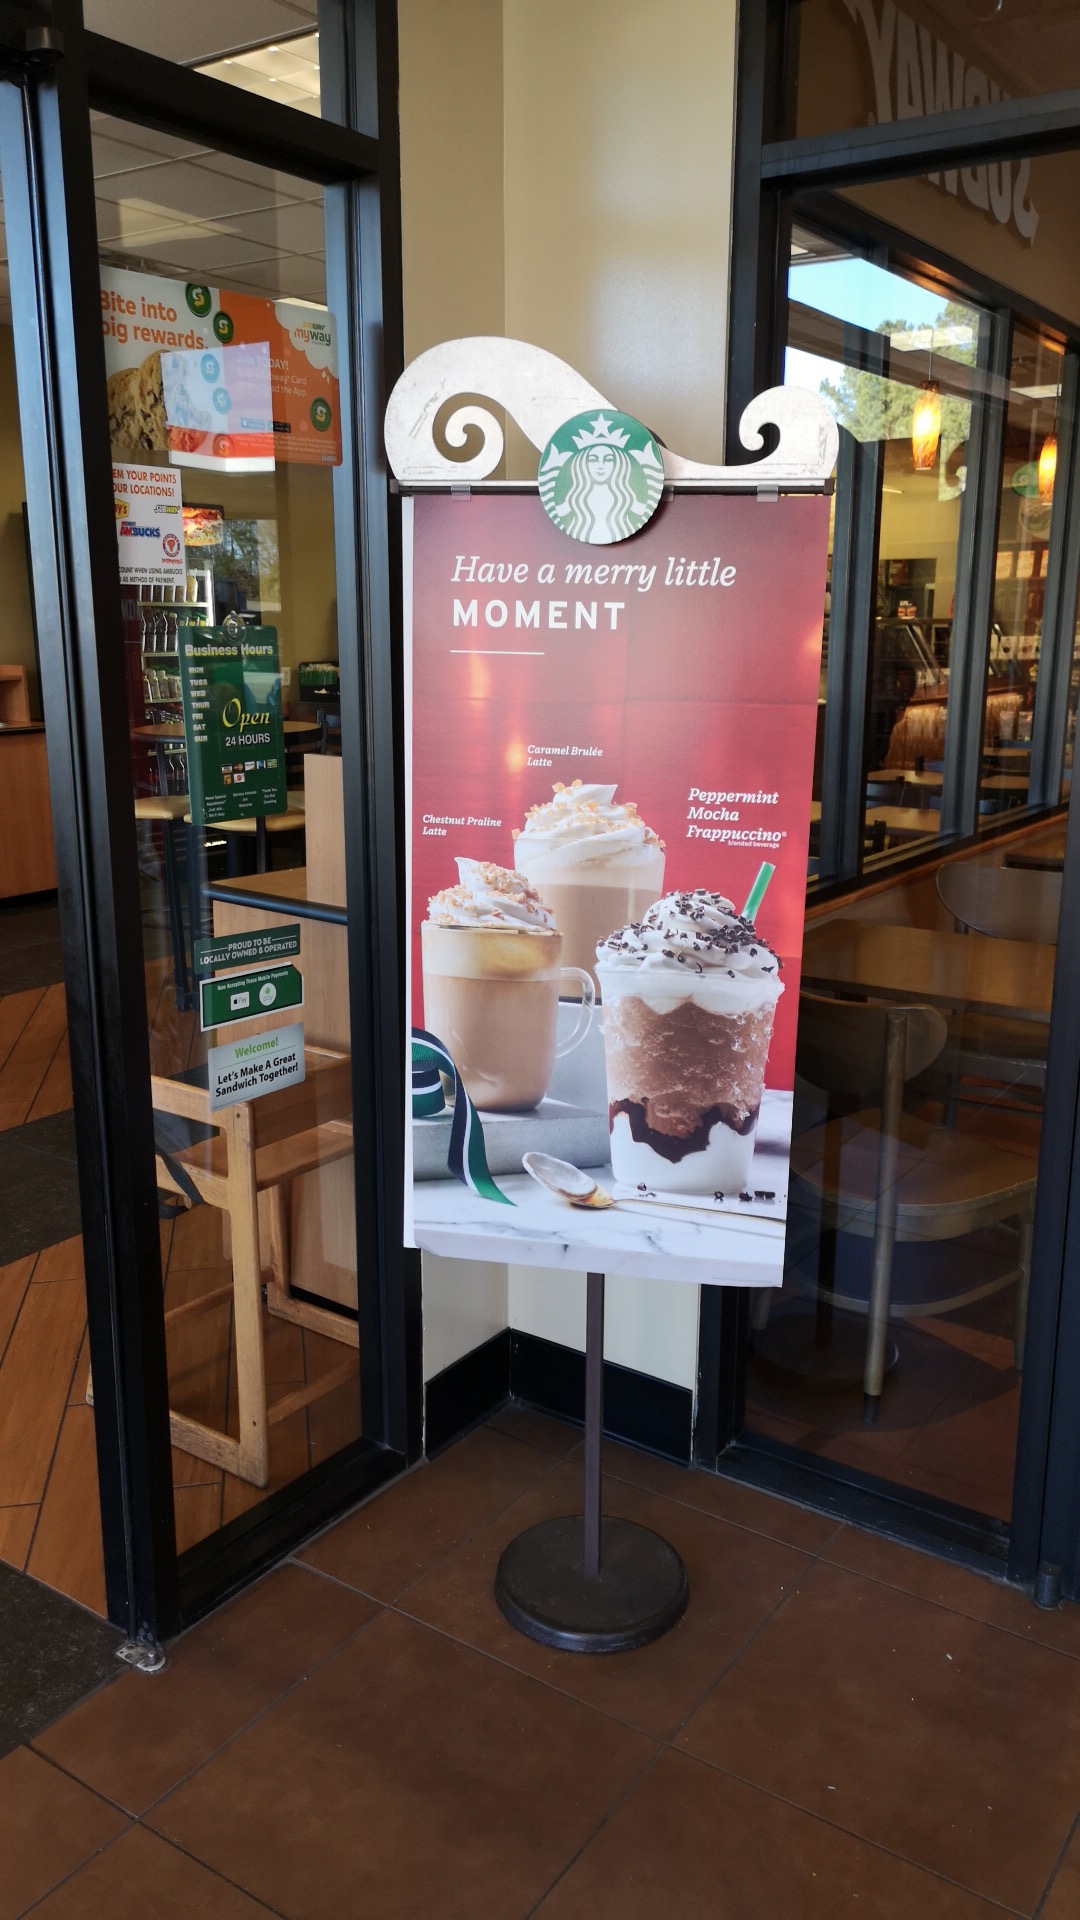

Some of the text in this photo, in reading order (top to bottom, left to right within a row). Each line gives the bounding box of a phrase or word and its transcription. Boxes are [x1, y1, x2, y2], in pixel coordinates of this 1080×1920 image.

[100, 290, 177, 323] Bite into
[133, 329, 208, 350] rewards.
[126, 470, 148, 482] YOUR
[150, 473, 177, 484] POINTS
[130, 484, 175, 497] LOCATIONS!
[451, 555, 737, 593] Have a merry little
[452, 598, 625, 630] MOMENT
[184, 644, 274, 657] Business Hours
[188, 666, 204, 674] MON
[222, 698, 270, 733] Open
[225, 733, 271, 746] 24 HOURS
[527, 744, 603, 757] Caramel Brulée
[527, 757, 553, 767] Latte
[687, 787, 779, 805] Peppermint
[422, 814, 502, 827] Chestnut Praline
[686, 806, 740, 822] Mocha
[422, 827, 447, 836] Latte
[753, 841, 780, 849] beverage
[228, 936, 272, 952] PROUD TO BE
[200, 940, 298, 965] LOCALLY OWNED & OPERATED
[226, 980, 246, 989] Accepting
[257, 974, 270, 983] Mobile
[270, 970, 289, 979] Payments
[235, 1036, 278, 1058] Welcome!
[217, 1053, 296, 1085] Let's Make A Great
[215, 1062, 299, 1098] Sandwich Together!
